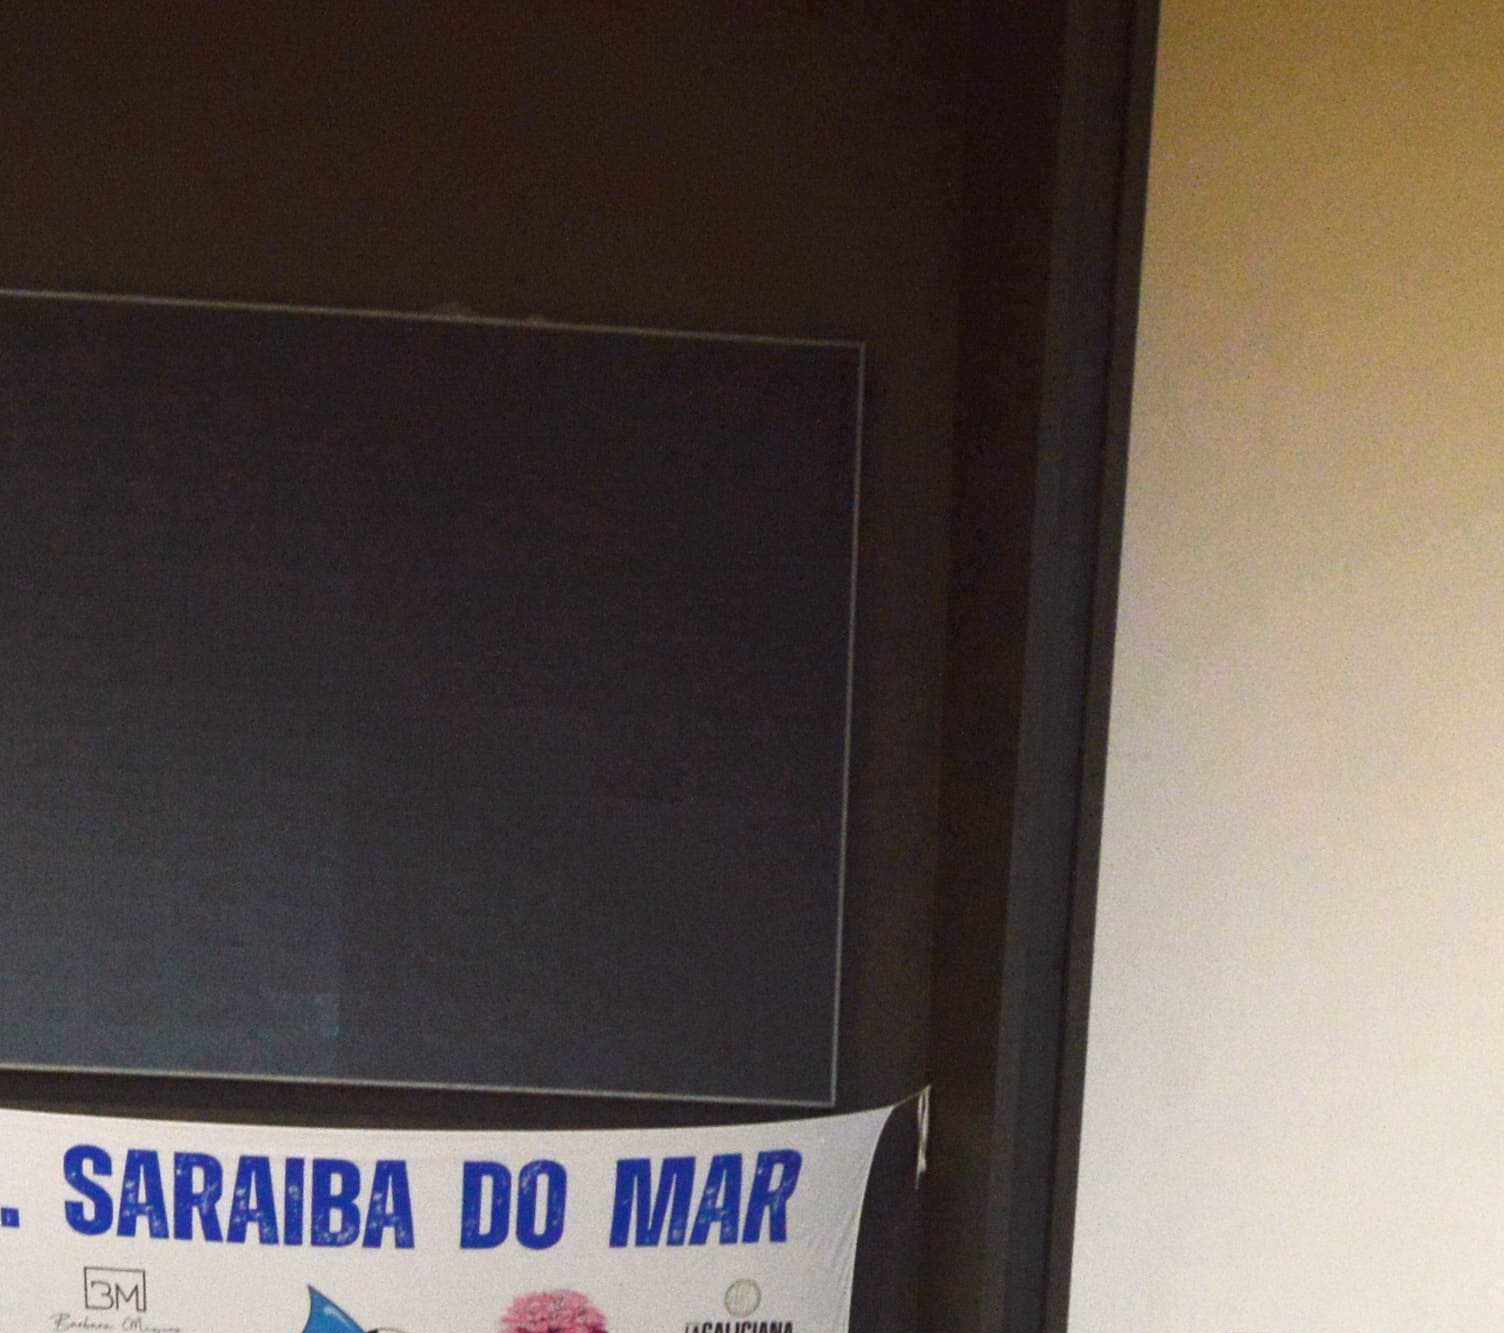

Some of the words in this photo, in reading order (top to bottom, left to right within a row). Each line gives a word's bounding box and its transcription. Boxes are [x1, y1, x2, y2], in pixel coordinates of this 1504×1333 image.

[62, 1144, 416, 1250] SARAIBA
[458, 1160, 568, 1251] DO
[608, 1148, 804, 1249] MAR
